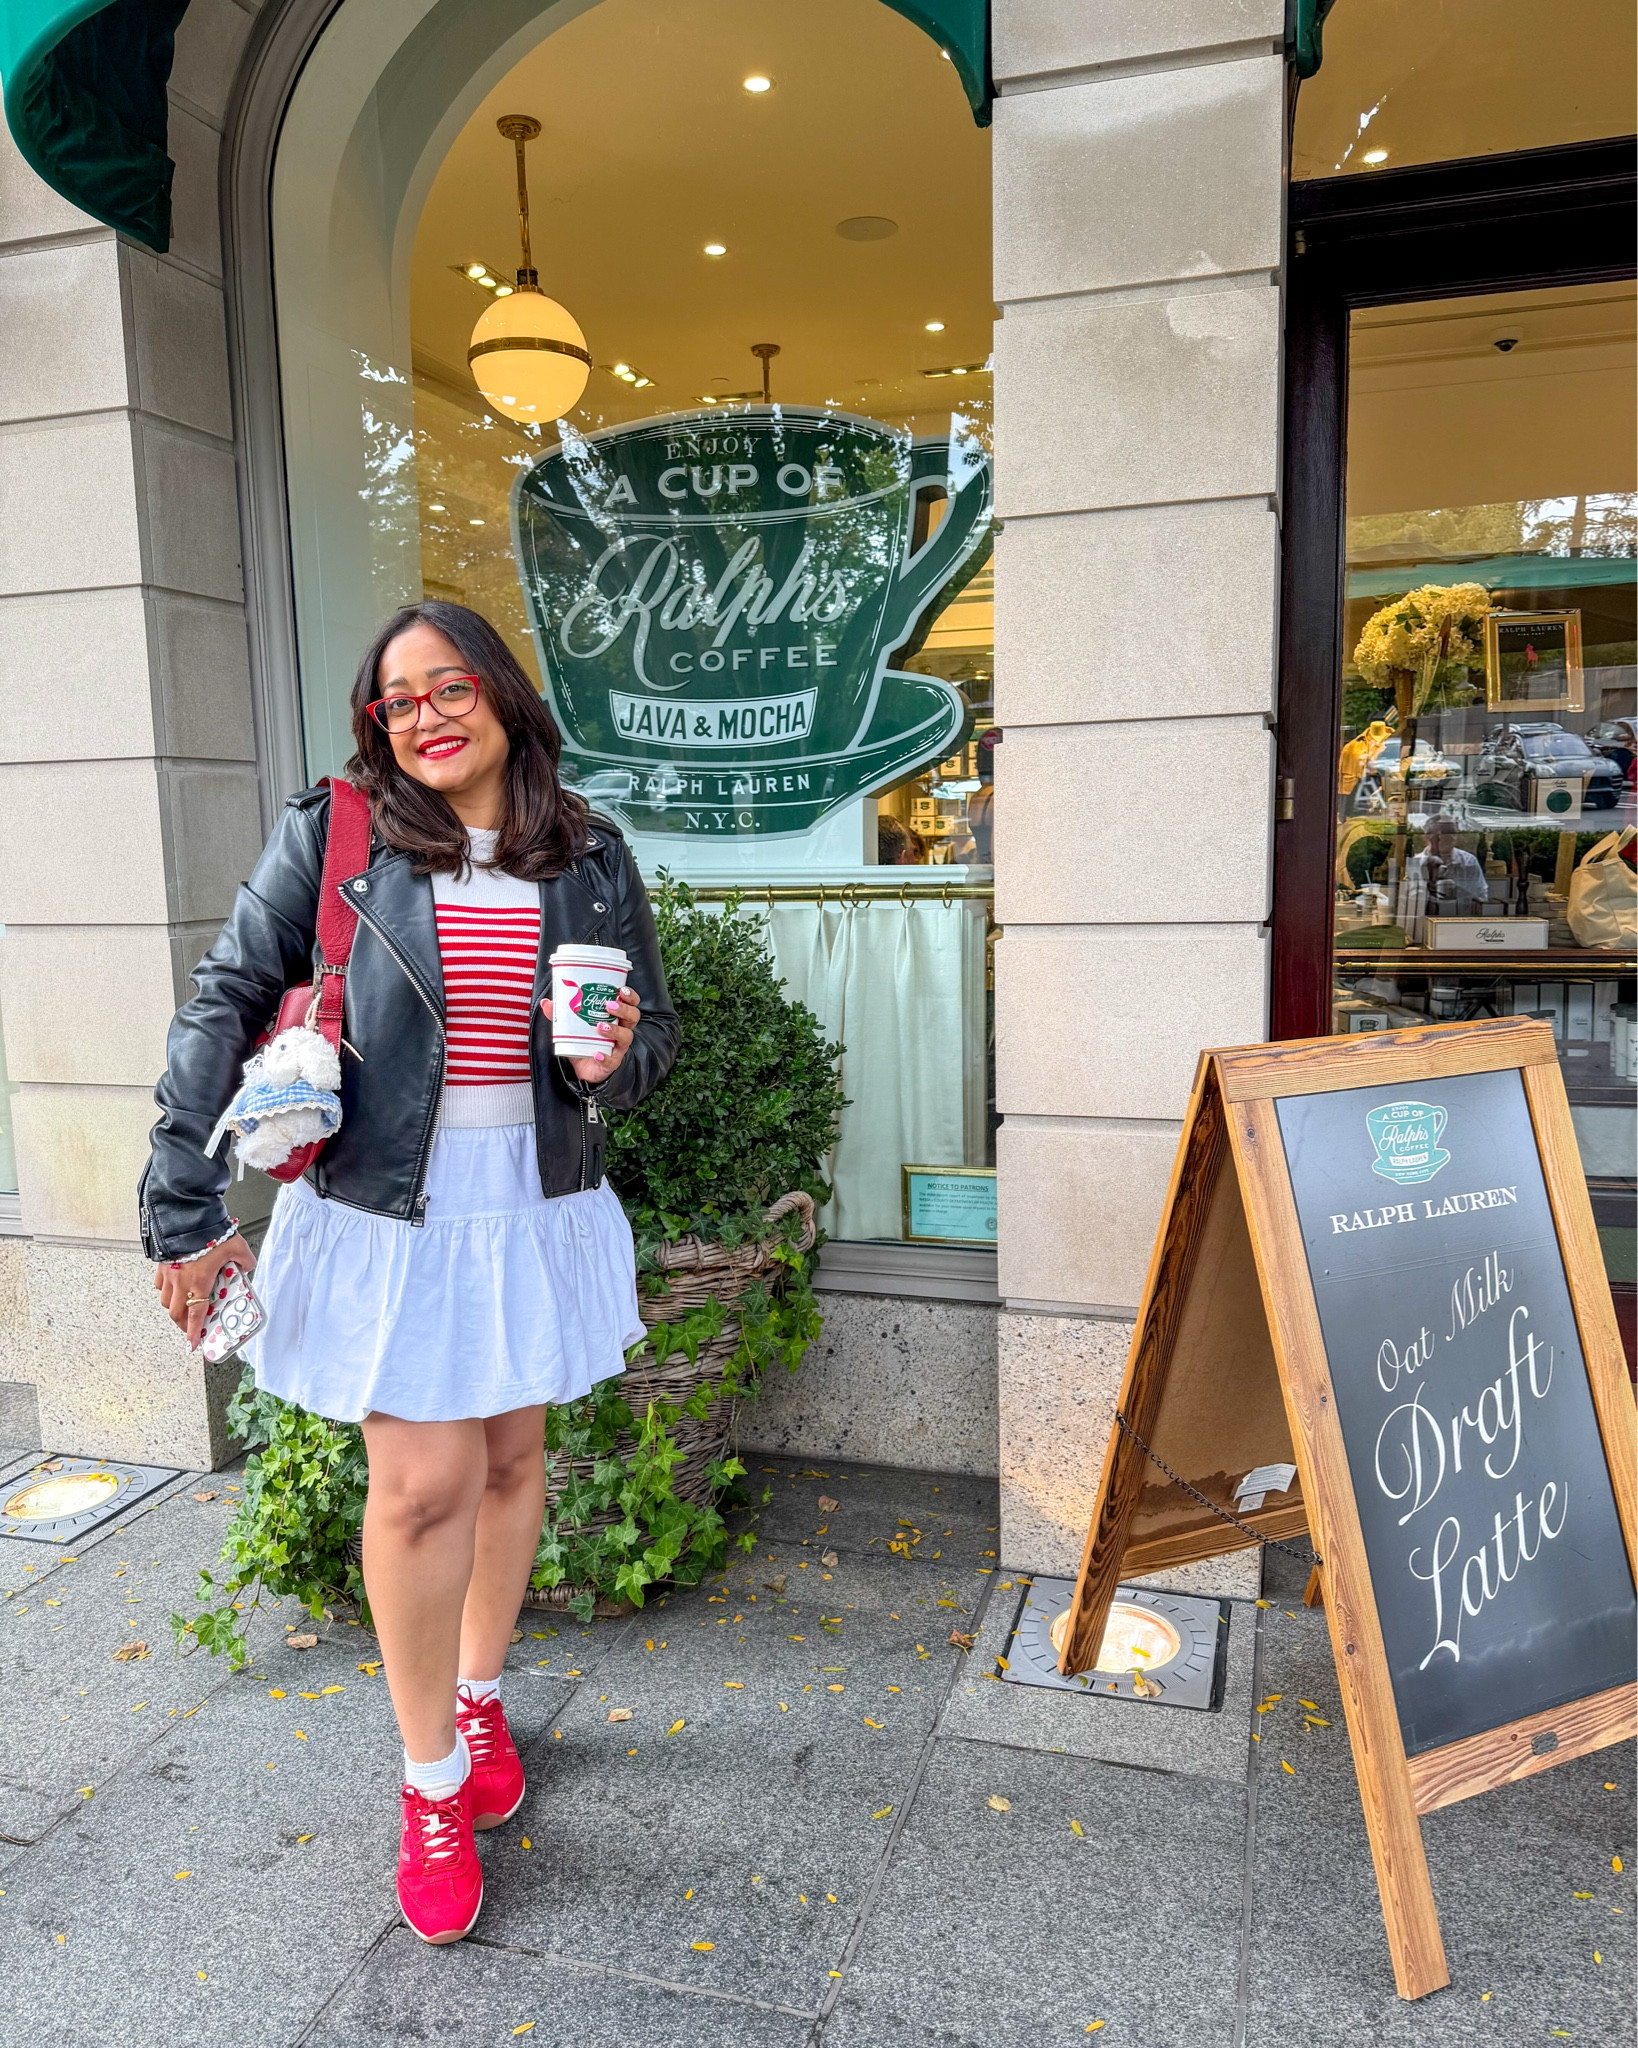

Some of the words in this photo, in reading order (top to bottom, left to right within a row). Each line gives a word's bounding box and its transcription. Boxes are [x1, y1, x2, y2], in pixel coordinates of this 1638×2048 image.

[664, 436, 761, 460] ENJOY
[603, 474, 639, 508] A
[657, 463, 759, 499] CUP
[776, 463, 846, 495] OF
[560, 533, 847, 691] Ralph's
[669, 645, 839, 673] COFFEE
[619, 702, 687, 740] JAVA
[693, 716, 712, 739] &
[718, 701, 807, 740] MOCHA
[628, 775, 703, 795] RALPH
[717, 773, 811, 795] LAUREN
[684, 810, 761, 829] N.Y.C.
[1379, 1124, 1429, 1155] Ralph's
[960, 1184, 989, 1192] PATRONS
[1329, 1203, 1416, 1234] RALPH
[1422, 1186, 1518, 1219] LAUREN
[1376, 1326, 1435, 1392] Oat
[1446, 1250, 1514, 1342] Milk
[1375, 1305, 1554, 1526] Draft
[1408, 1481, 1568, 1671] Latte
